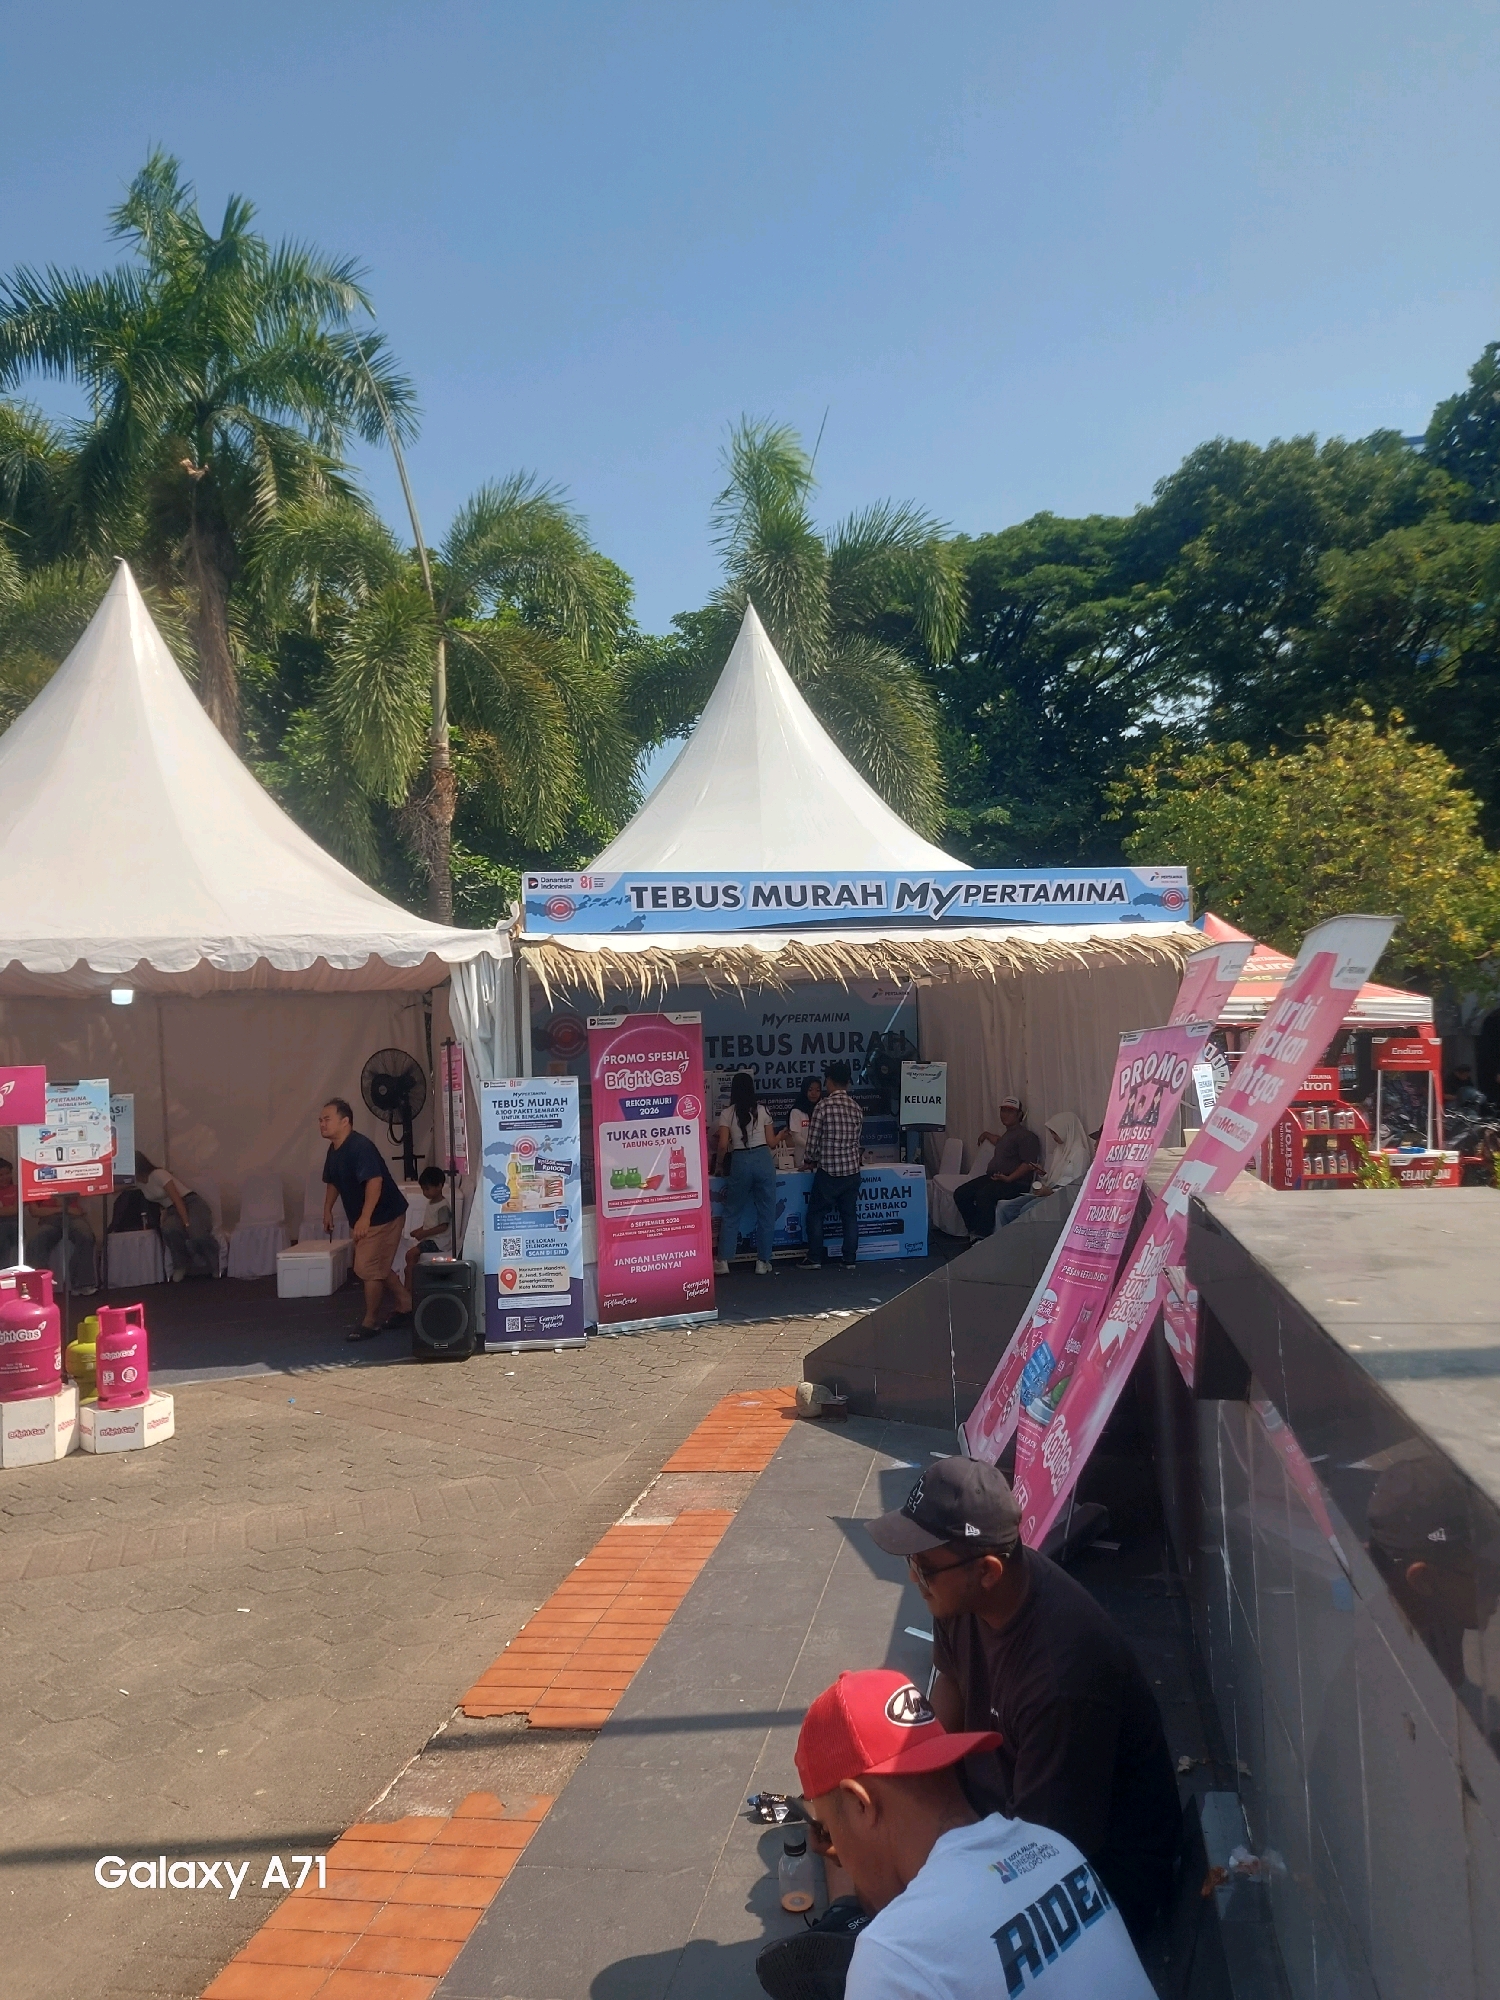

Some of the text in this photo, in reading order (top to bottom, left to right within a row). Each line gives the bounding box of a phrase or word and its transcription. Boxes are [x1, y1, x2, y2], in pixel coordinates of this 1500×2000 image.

[630, 884, 742, 909] TEBUS
[751, 884, 884, 908] MURAH
[761, 1012, 851, 1030] MyPERTAMINA
[704, 1030, 906, 1059] TEBUS MURAH
[1391, 1047, 1424, 1055] Enduro
[603, 1050, 690, 1065] PROMO SPESIAL
[764, 1060, 816, 1076] PAKET
[1120, 1051, 1188, 1099] PROMO
[606, 1070, 681, 1090] Bright Gas
[492, 1097, 568, 1109] TEBUS MURAH
[625, 1097, 672, 1108] REKOR MURI
[904, 1095, 942, 1105] KELUAR
[639, 1106, 660, 1116] 2026
[606, 1124, 691, 1142] TUKAR GRATIS
[621, 1137, 677, 1149] TABUNG 5,5 KG
[1105, 1144, 1125, 1162] ASN
[1284, 1121, 1293, 1188] Fastron
[864, 1200, 908, 1212] SEMBAKO
[885, 1210, 900, 1219] NTT
[614, 1249, 697, 1267] JANGAN LEWATKAN
[1060, 1265, 1081, 1278] PESAN
[17, 1327, 43, 1343] Gas
[1008, 1852, 1021, 1862] KOTA
[1012, 1850, 1037, 1869] SINERGI
[1018, 1848, 1060, 1875] PALOPO MAJU
[990, 1862, 1112, 2000] RIDE
